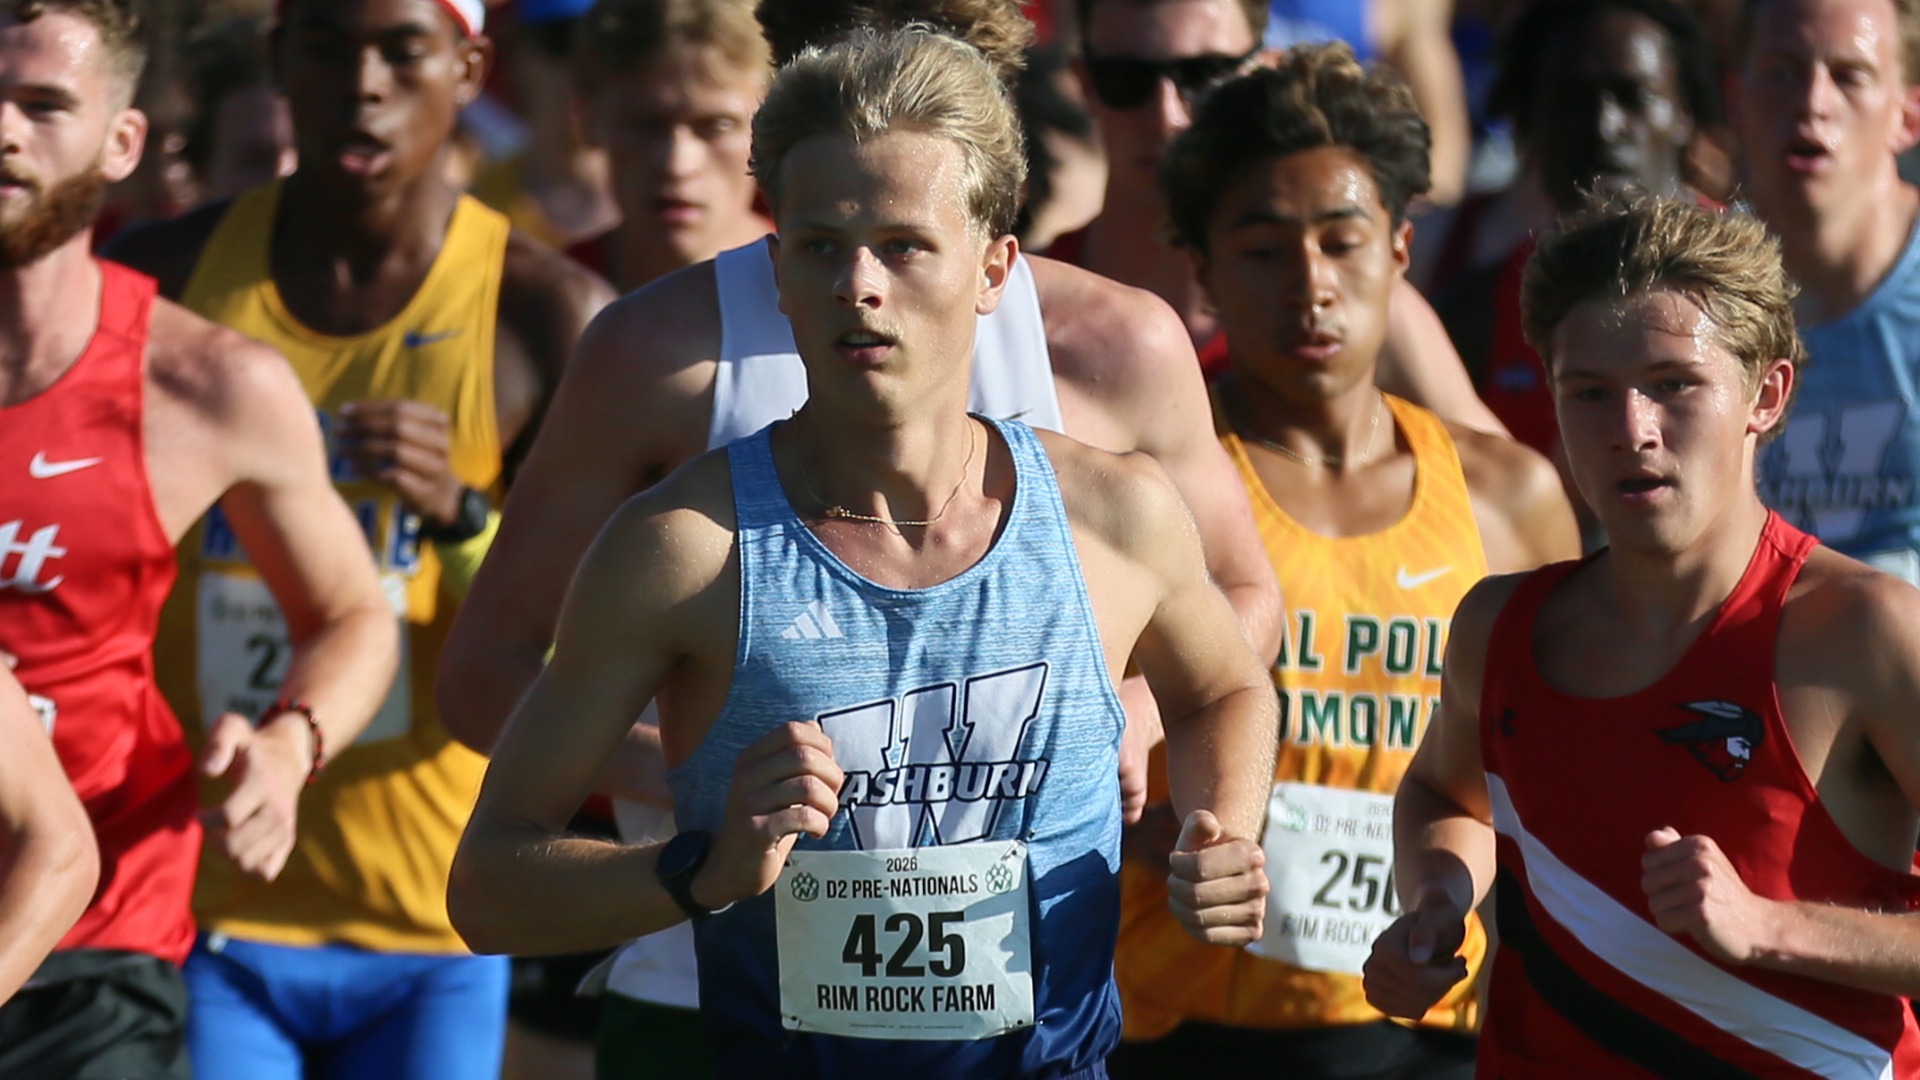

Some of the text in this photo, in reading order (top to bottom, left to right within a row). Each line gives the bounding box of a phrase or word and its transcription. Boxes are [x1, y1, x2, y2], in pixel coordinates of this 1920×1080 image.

[1343, 615, 1450, 677] POL
[1279, 688, 1440, 750] MON
[838, 758, 1050, 808] ASHBURN
[886, 857, 918, 873] 2026
[826, 874, 978, 899] D2 PRE-NATIONALS
[842, 911, 966, 979] 425
[1325, 917, 1374, 944] ROCK
[817, 983, 996, 1013] RIM ROCK FARM
